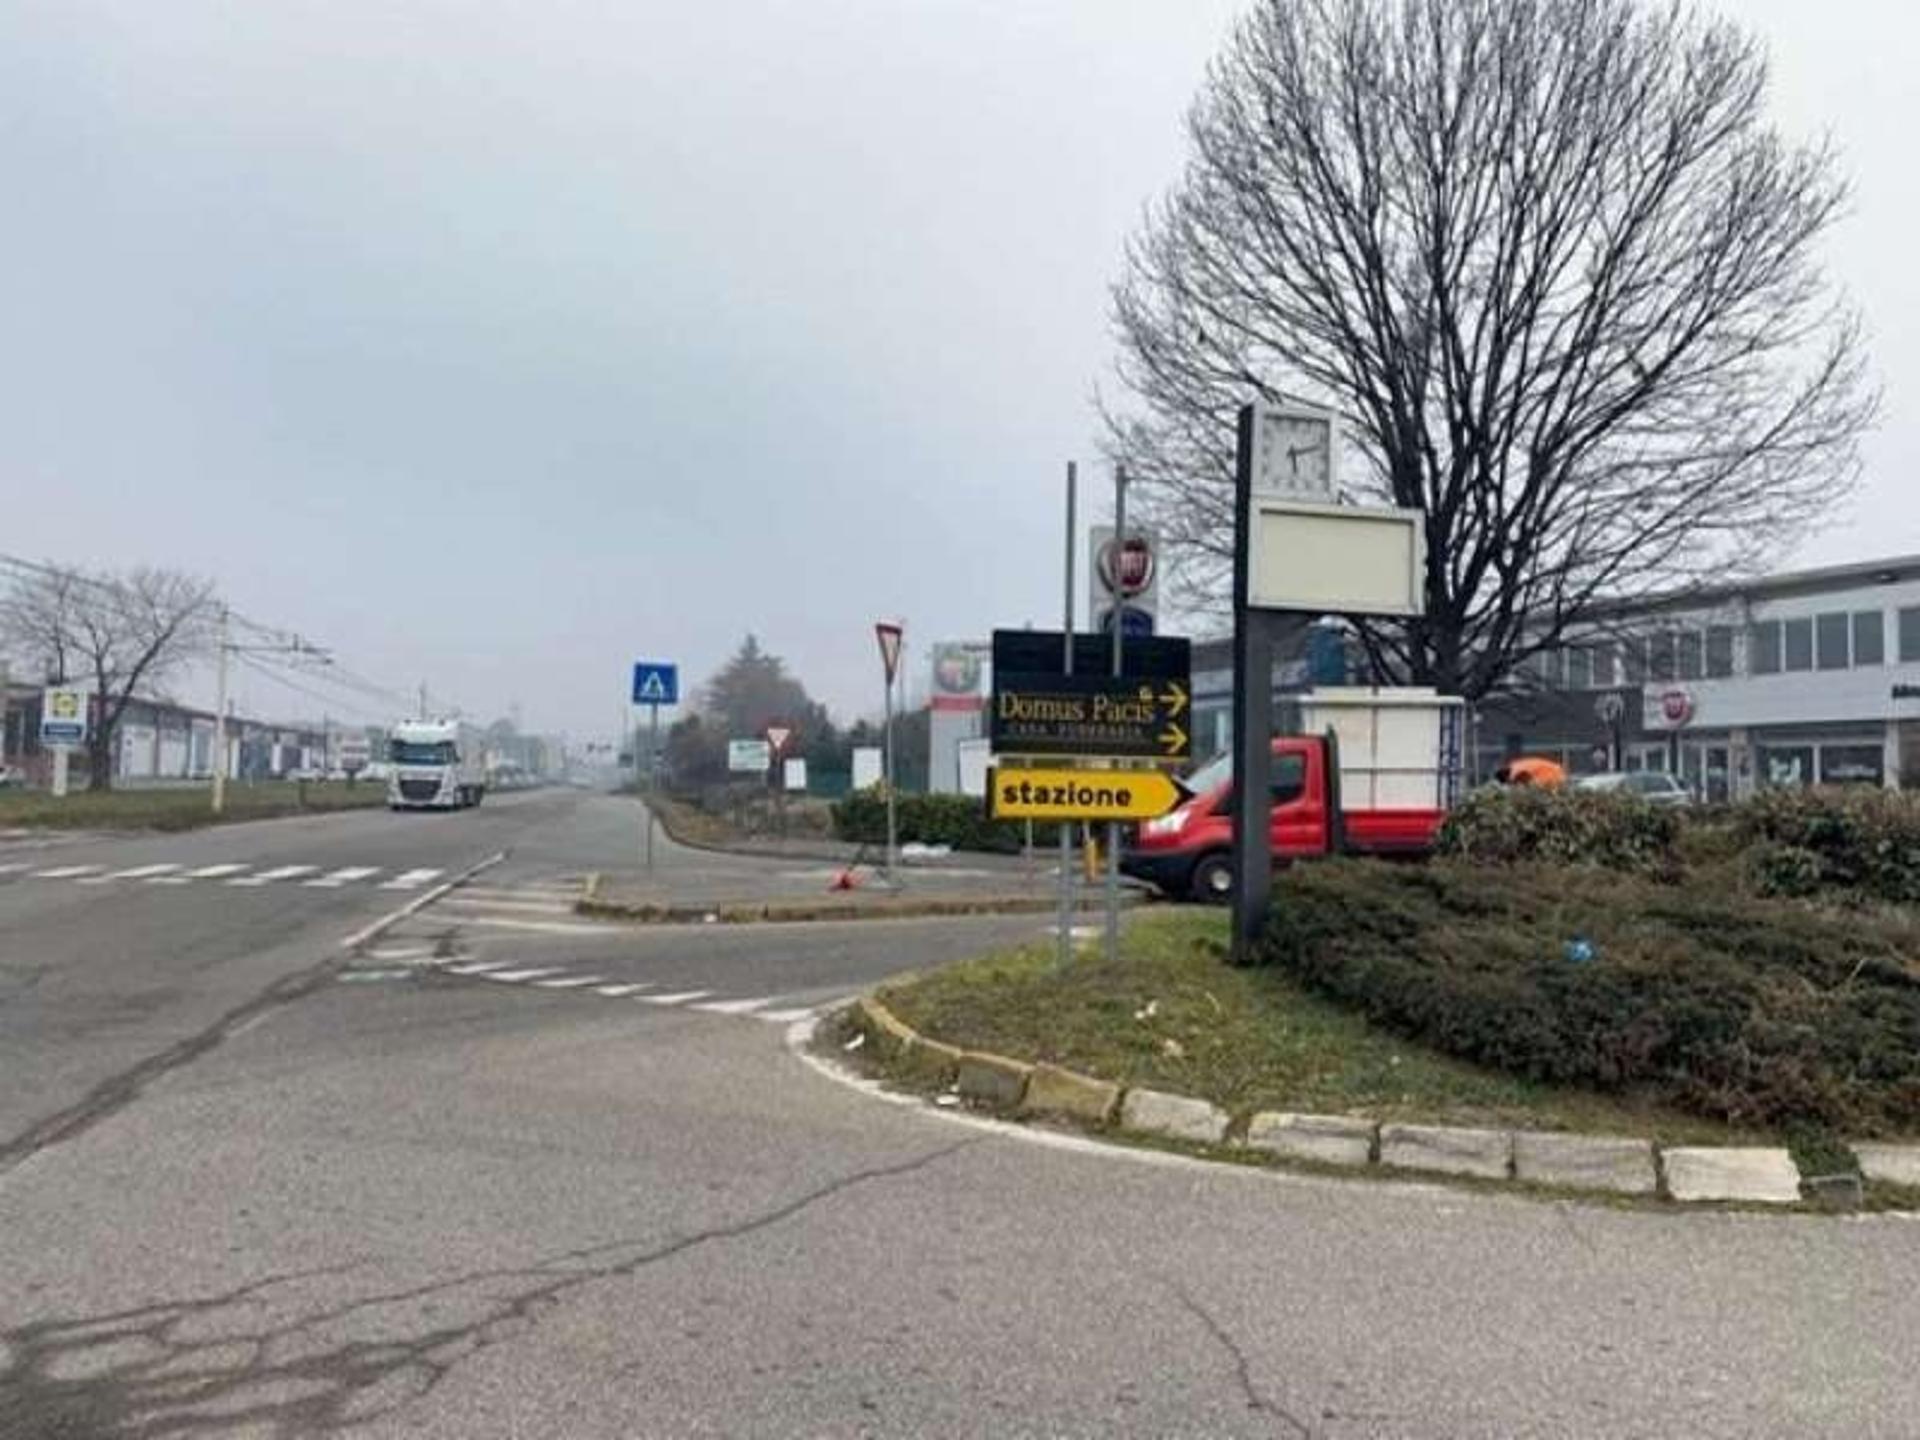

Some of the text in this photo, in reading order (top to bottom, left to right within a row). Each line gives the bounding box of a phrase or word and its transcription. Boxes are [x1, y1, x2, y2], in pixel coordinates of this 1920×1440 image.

[999, 692, 1154, 723] Domus Pacis
[1002, 780, 1132, 807] stazione
